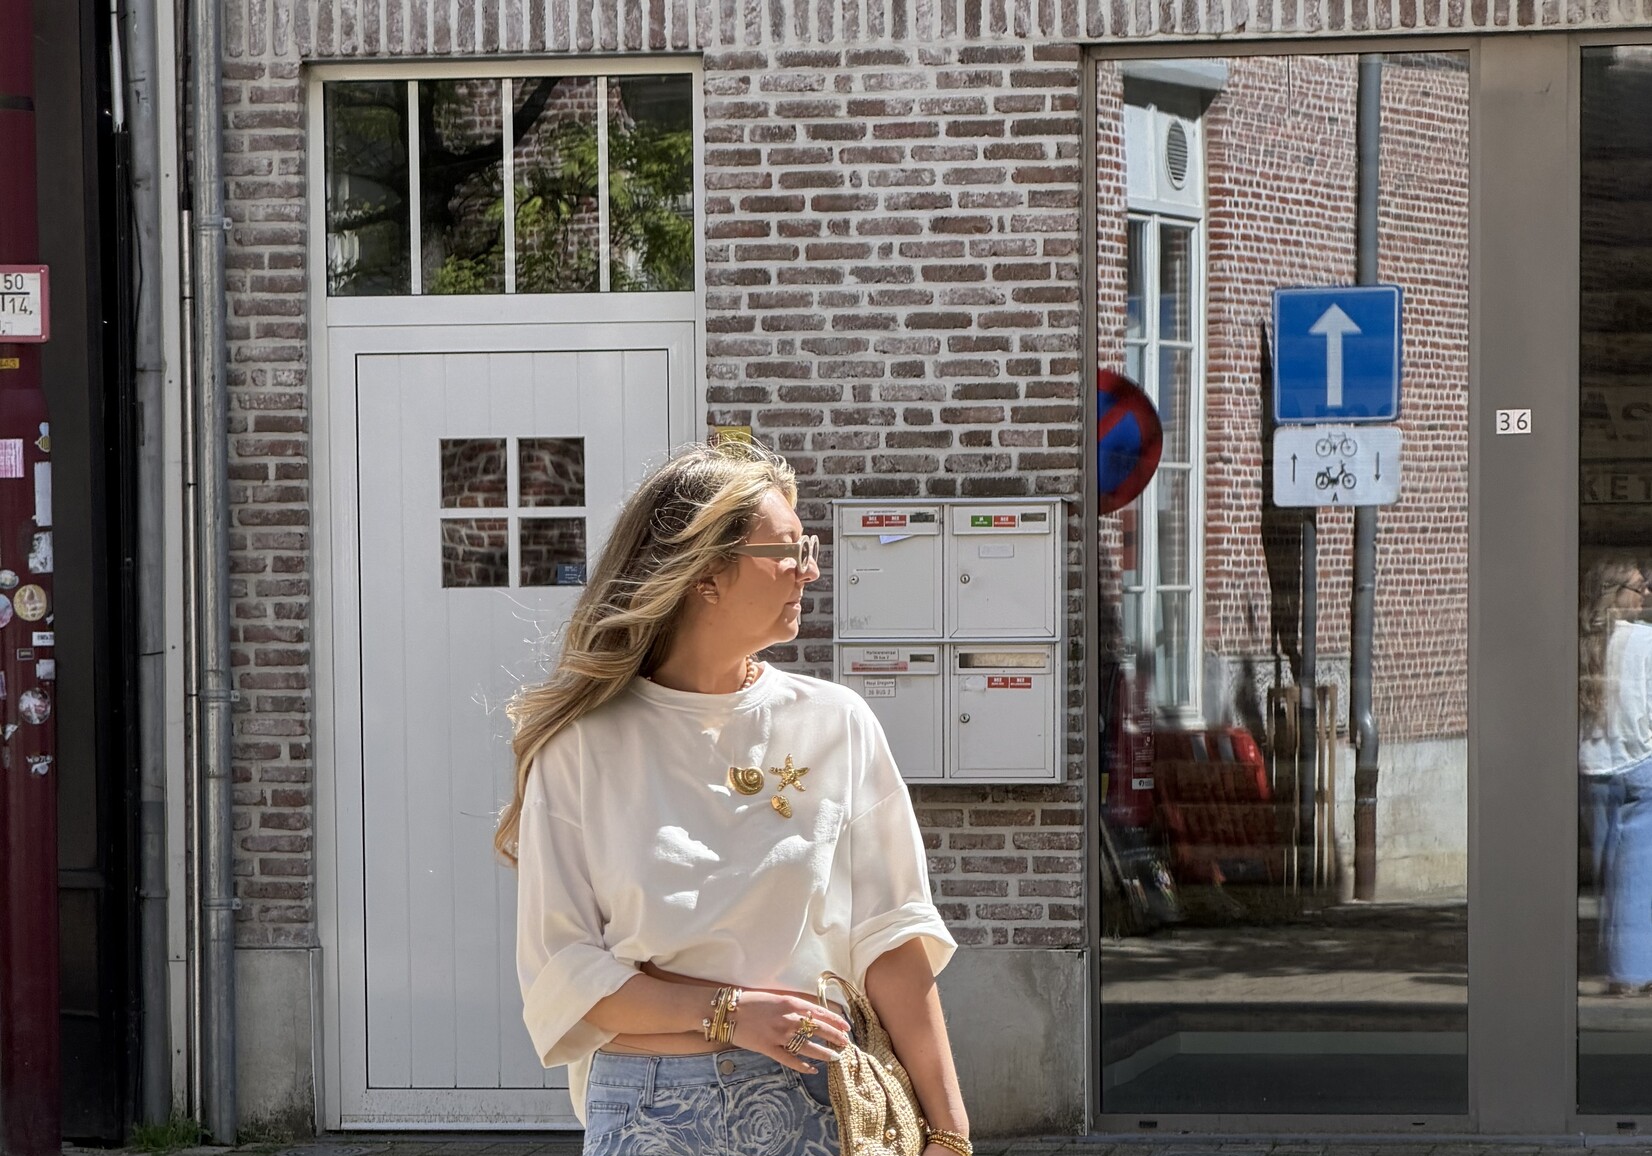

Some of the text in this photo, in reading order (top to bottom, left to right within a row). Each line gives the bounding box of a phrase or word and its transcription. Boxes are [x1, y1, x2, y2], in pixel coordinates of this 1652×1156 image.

[3, 273, 24, 291] 50
[1500, 412, 1528, 431] 36
[1331, 491, 1339, 503] A
